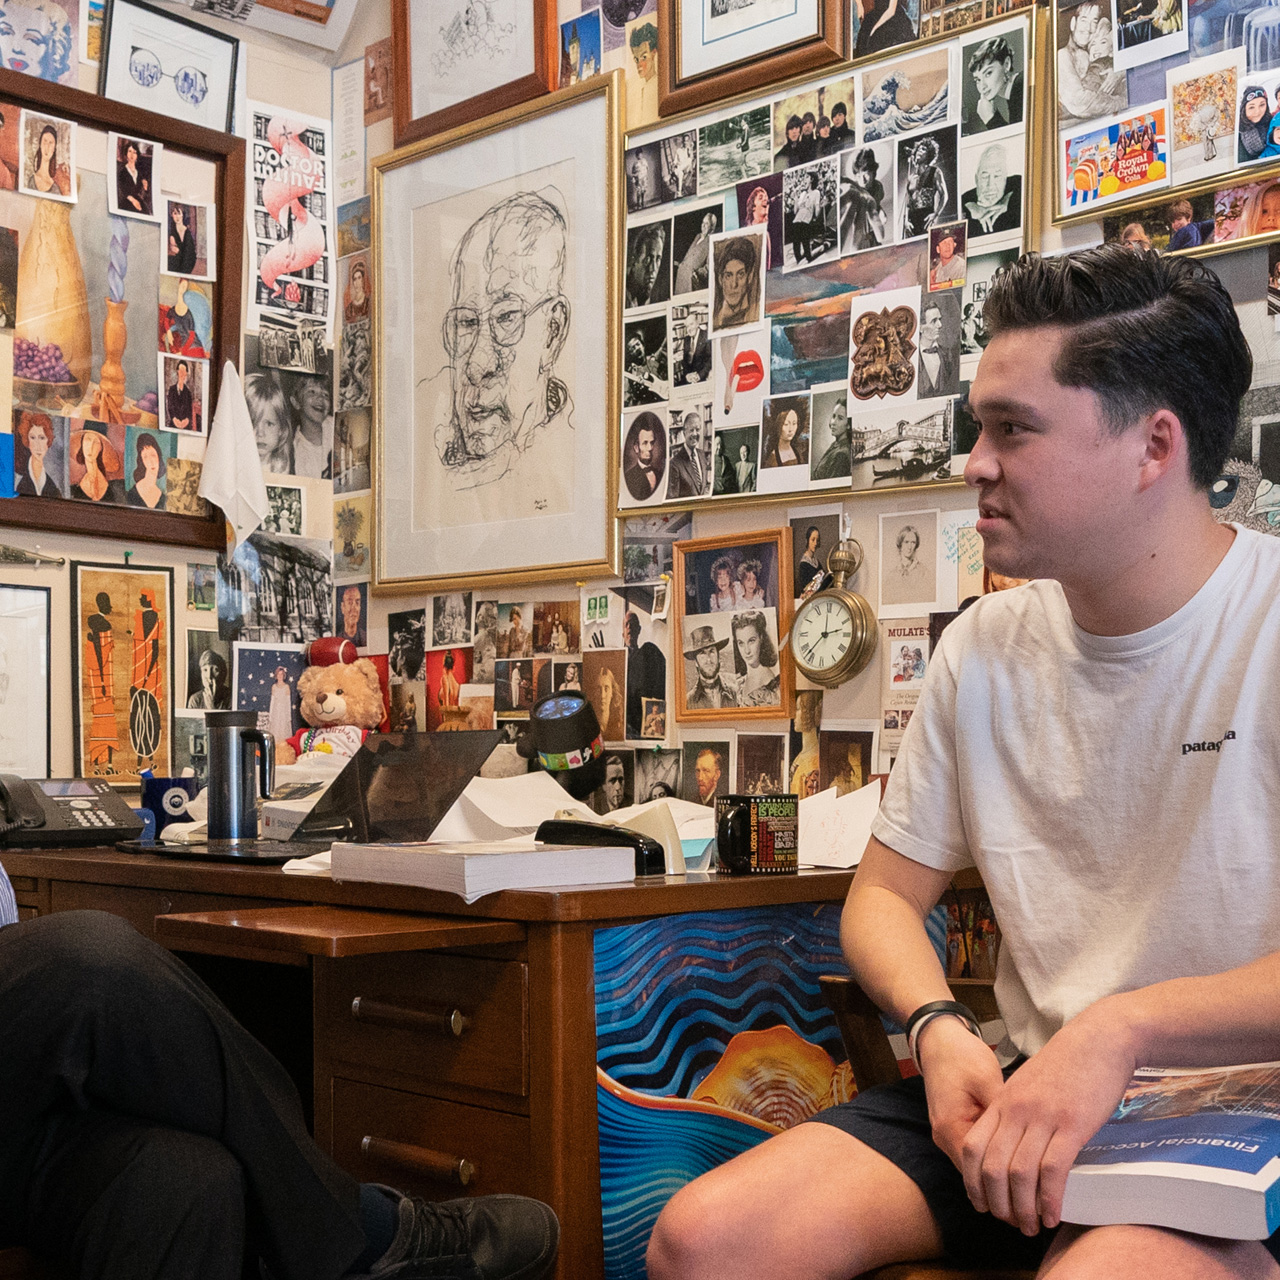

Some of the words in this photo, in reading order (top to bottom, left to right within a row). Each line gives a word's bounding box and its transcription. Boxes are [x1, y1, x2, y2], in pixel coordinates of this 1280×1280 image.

[254, 145, 324, 177] DOCTOR
[1118, 153, 1147, 169] Royal
[1117, 164, 1149, 178] Crown
[1124, 174, 1142, 183] Cola
[888, 627, 931, 637] MULATE'S
[769, 808, 795, 816] PEOPLE
[1157, 1136, 1261, 1154] Financial
